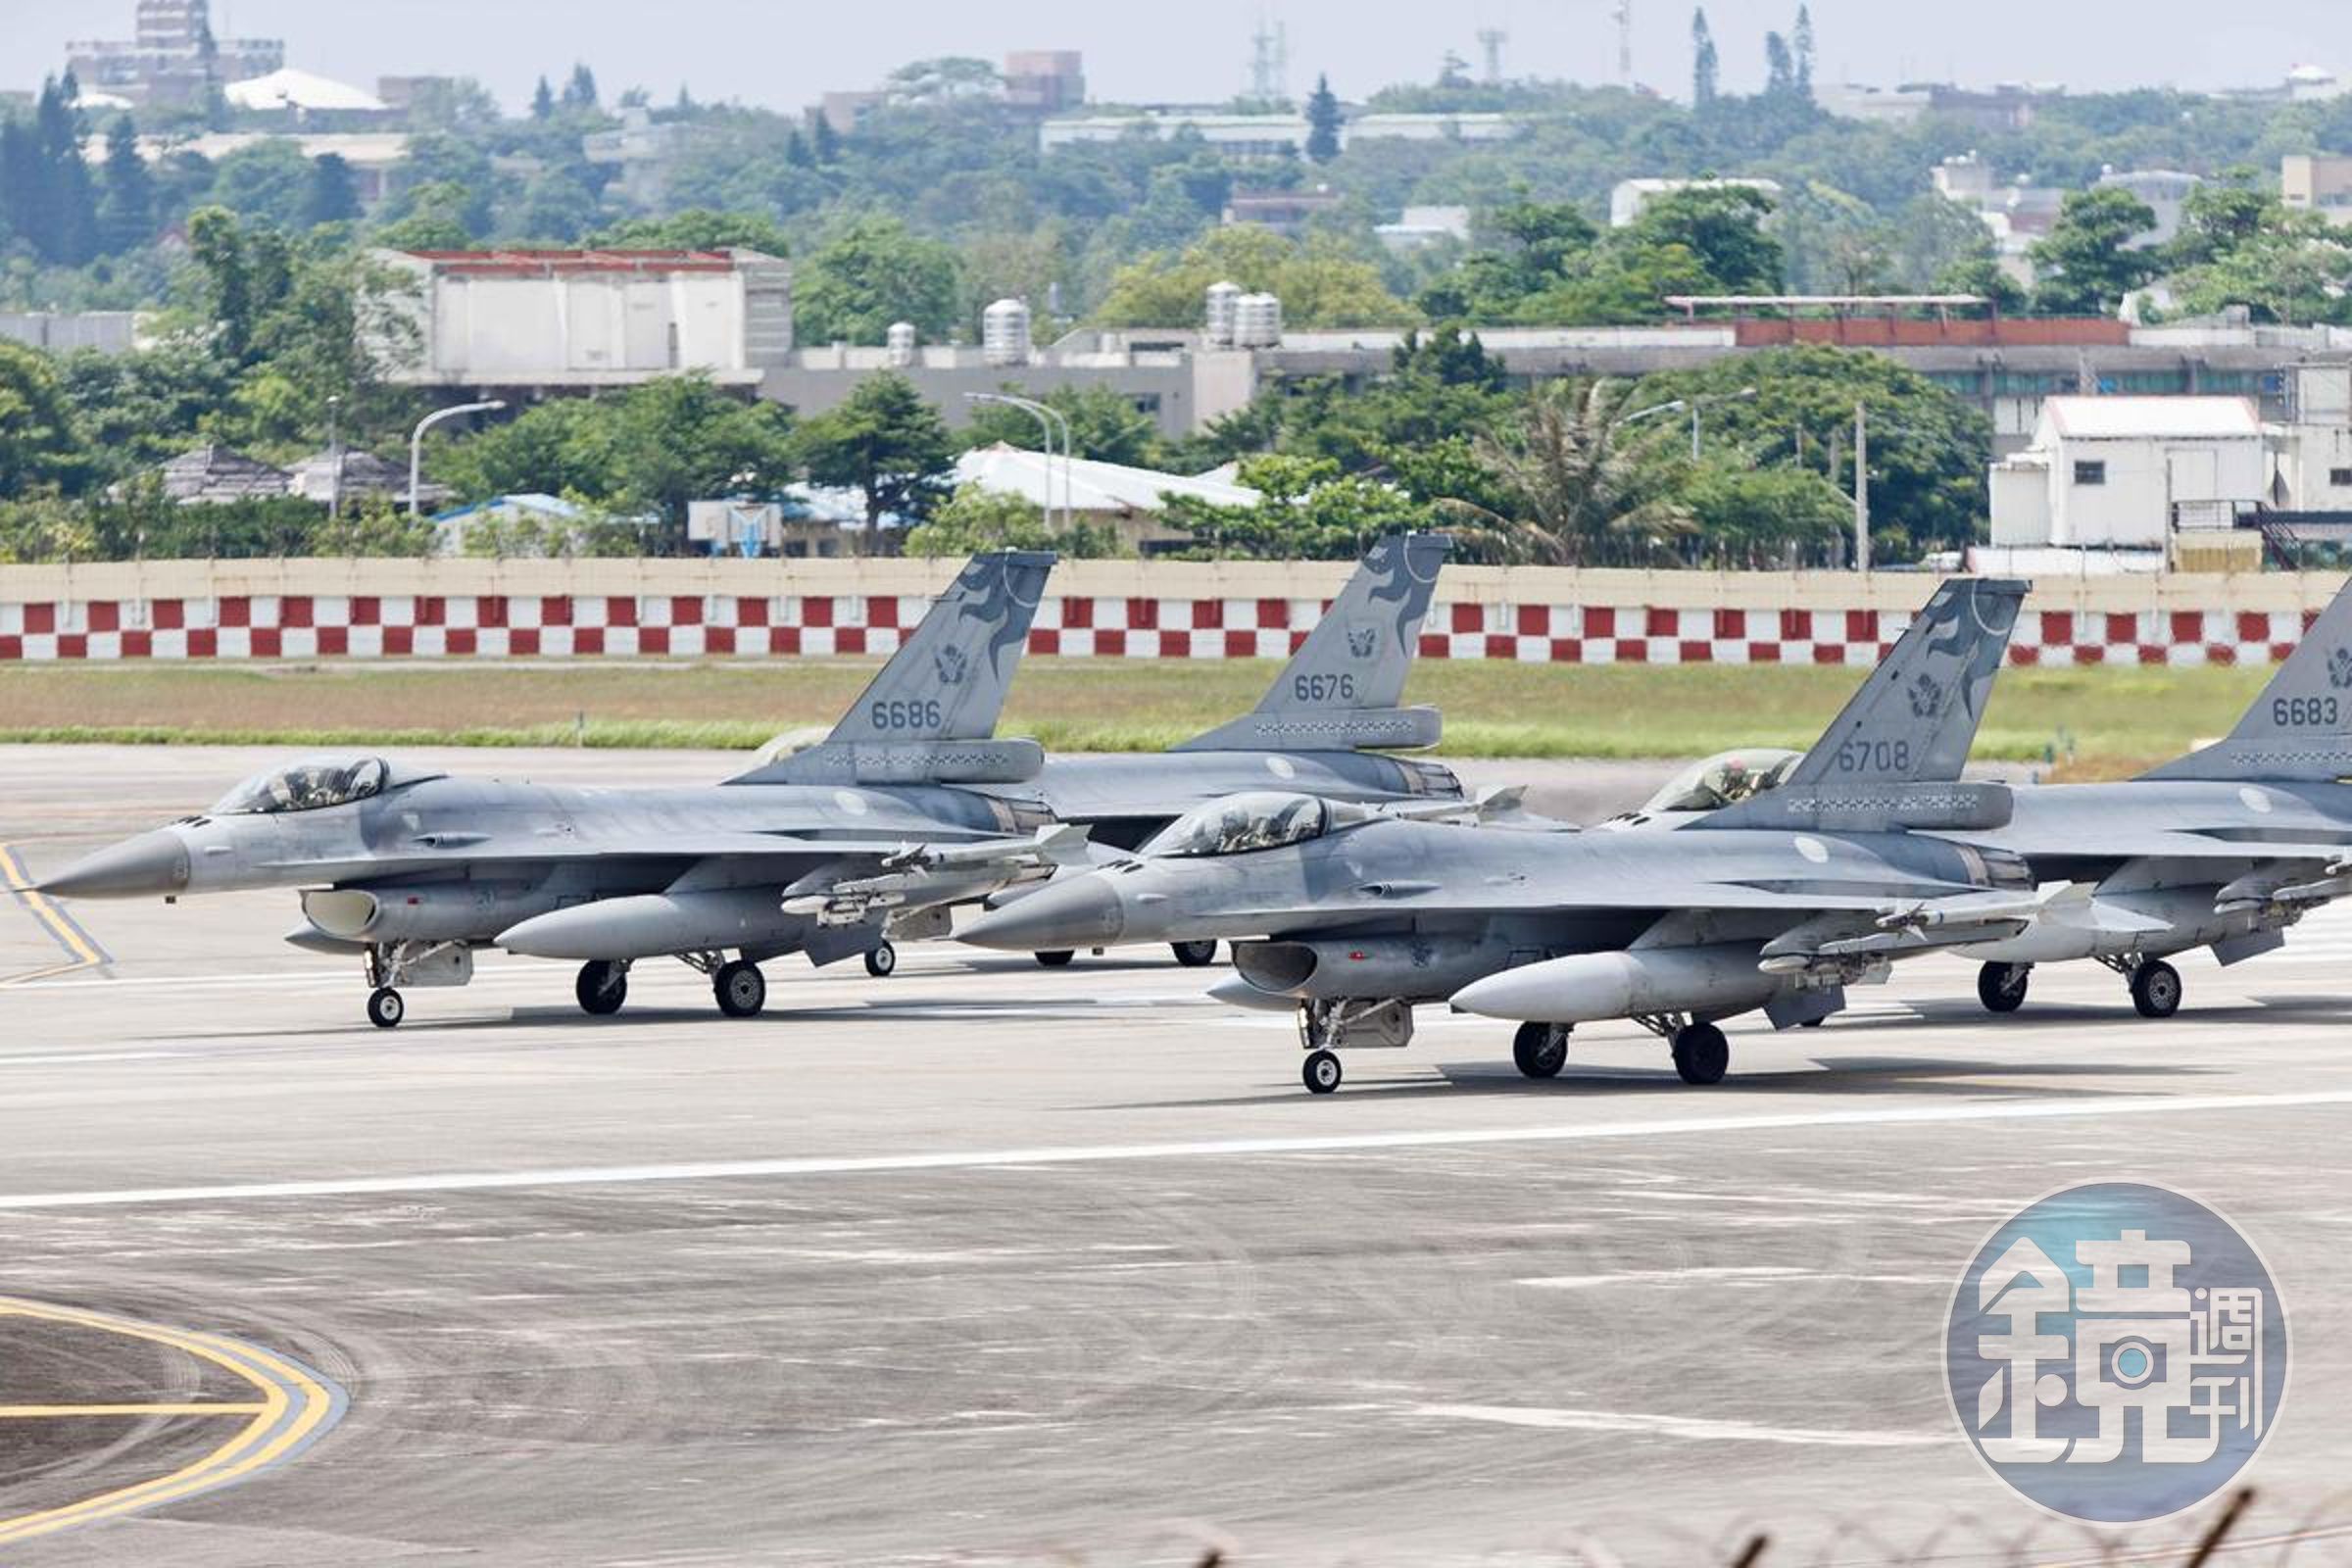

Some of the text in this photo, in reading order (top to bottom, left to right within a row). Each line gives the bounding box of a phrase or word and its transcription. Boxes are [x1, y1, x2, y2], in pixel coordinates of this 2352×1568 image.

[1295, 673, 1353, 701] 6676
[871, 700, 941, 729] 6686
[2273, 697, 2337, 725] 6683
[1838, 740, 1909, 771] 6708
